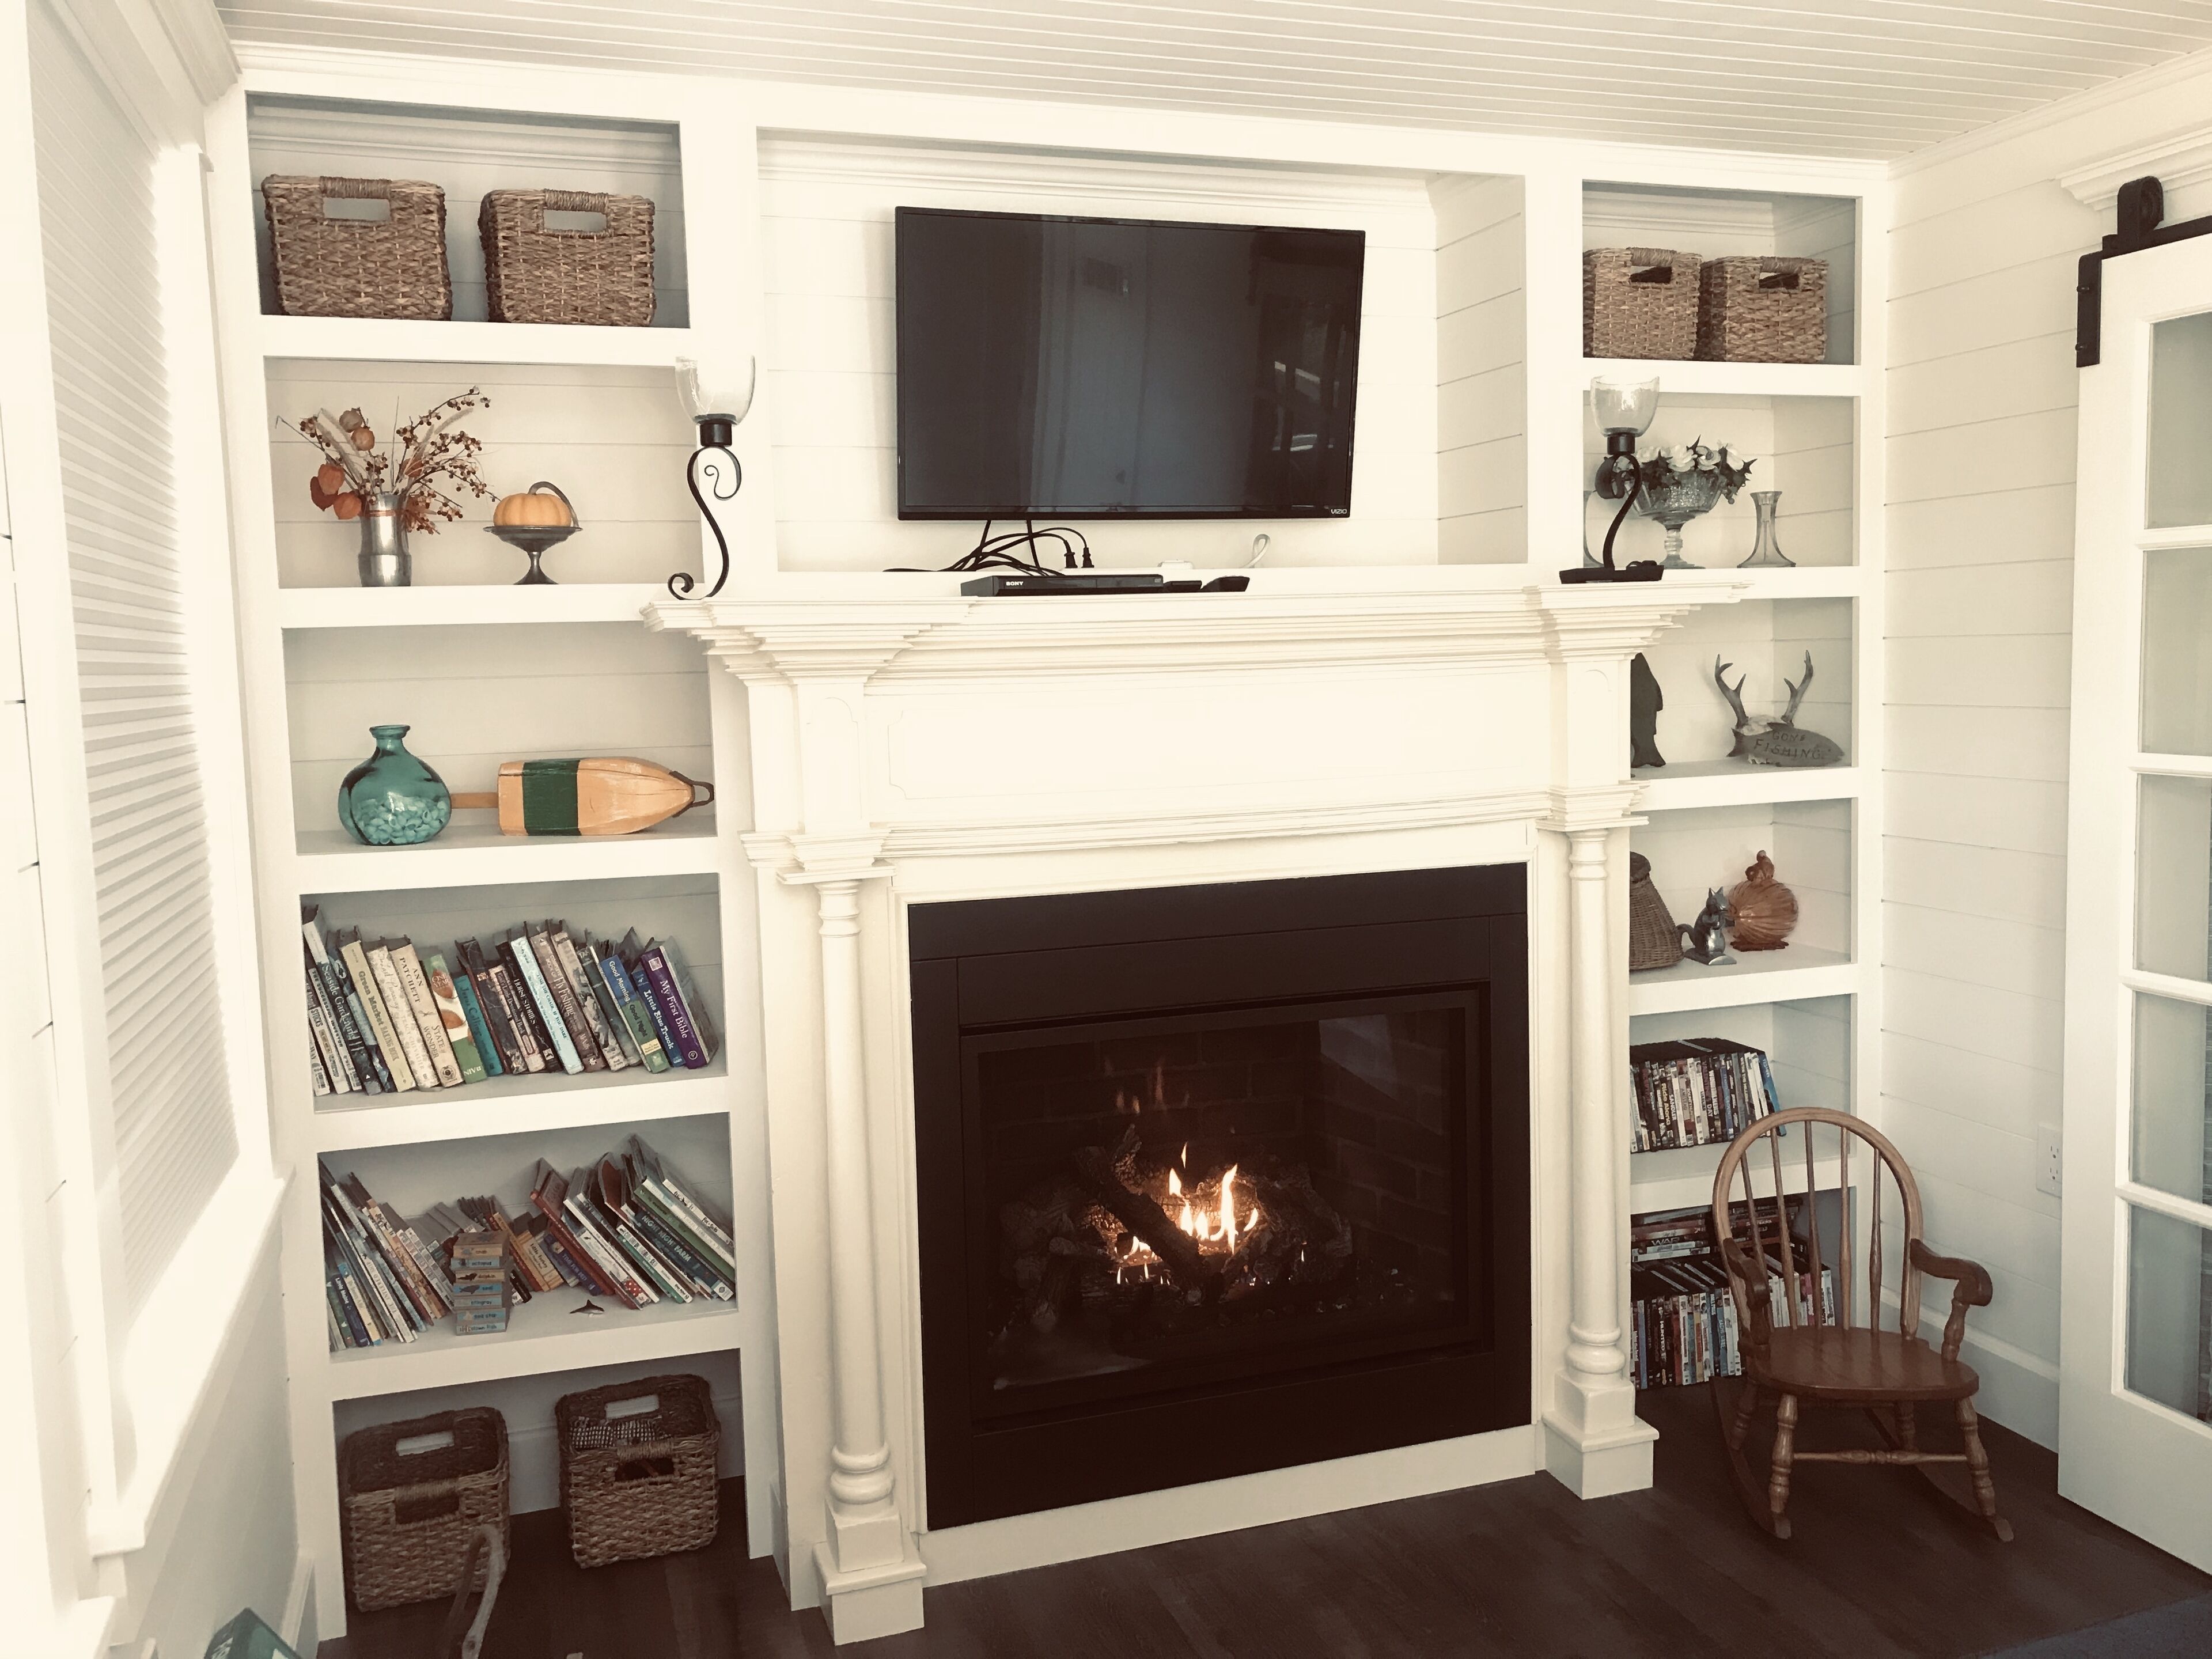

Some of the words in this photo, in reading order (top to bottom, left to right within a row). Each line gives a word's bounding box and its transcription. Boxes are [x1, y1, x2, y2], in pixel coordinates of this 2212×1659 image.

[1754, 738, 1821, 760] FISHING
[1772, 732, 1806, 742] GONE
[322, 965, 339, 997] Seaside
[400, 957, 421, 1003] PATCHETT
[412, 968, 423, 986] ANN
[358, 971, 371, 995] Green
[368, 997, 385, 1026] Market
[560, 987, 576, 1017] Fishing
[609, 961, 620, 978] Good
[616, 978, 631, 1003] Morning,
[629, 1004, 640, 1022] Good
[637, 1020, 648, 1037] Night
[660, 979, 671, 995] My
[666, 995, 679, 1016] First
[675, 1016, 688, 1039] Bible
[643, 990, 657, 1011] Little
[654, 1010, 664, 1028] Blue
[660, 1026, 674, 1050] Truck
[423, 1027, 438, 1058] WONDER
[432, 1025, 445, 1048] STATE
[1669, 1094, 1677, 1120] SANDLER
[642, 1215, 661, 1234] NIGHT
[674, 1245, 692, 1262] FARM
